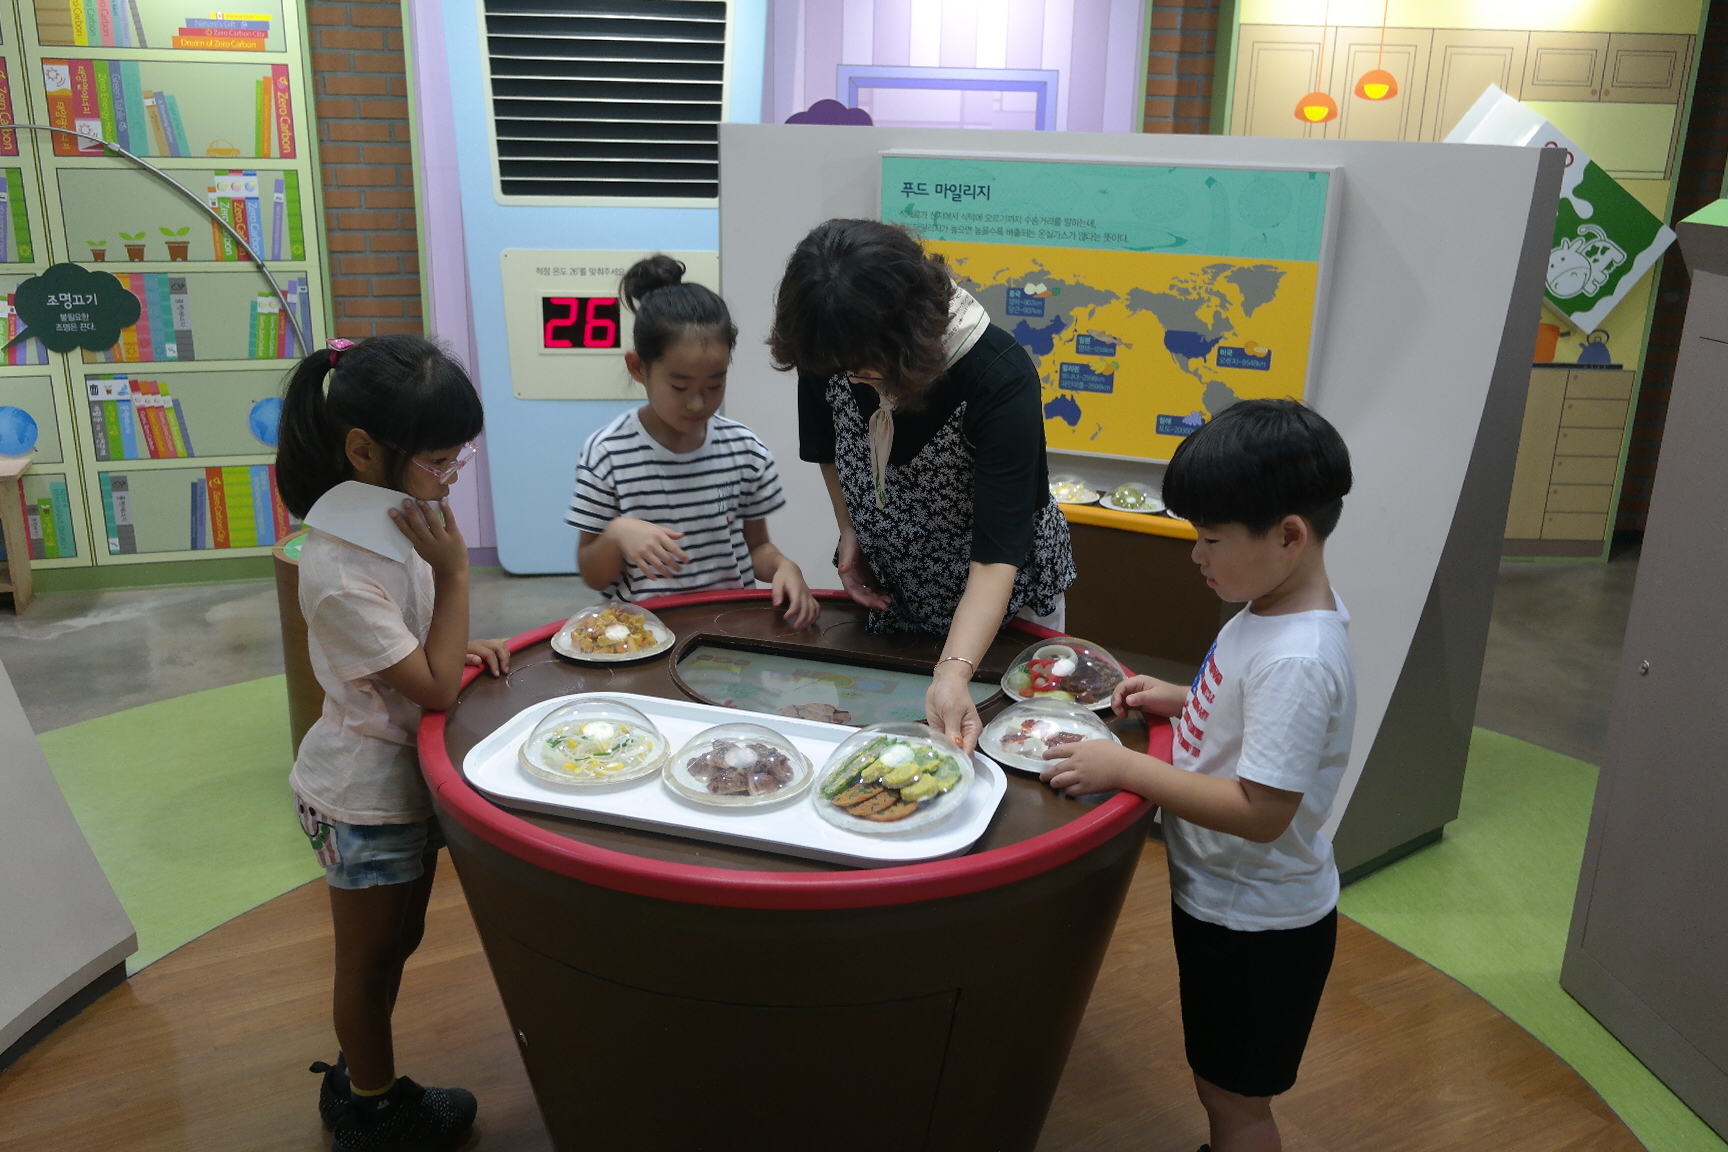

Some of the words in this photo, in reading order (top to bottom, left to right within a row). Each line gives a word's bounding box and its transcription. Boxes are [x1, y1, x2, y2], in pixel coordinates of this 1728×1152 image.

[73, 7, 84, 36] Carbon
[86, 8, 97, 36] Carbon
[100, 8, 110, 37] Carbon
[181, 38, 205, 47] Dream
[206, 39, 213, 47] of
[214, 39, 230, 48] Zero
[231, 39, 257, 49] Carbon
[213, 29, 230, 37] Zero
[231, 30, 251, 38] Carbon
[252, 30, 265, 39] City
[75, 65, 91, 115] 태양열에너지
[98, 73, 108, 92] Zero
[112, 73, 121, 96] Green
[100, 92, 110, 121] Energy
[115, 97, 126, 120] Table
[276, 91, 289, 115] Zero
[1, 112, 13, 150] Cabon
[105, 122, 113, 143] Hous
[279, 115, 291, 153] Carbon
[900, 181, 930, 198] 푸드
[934, 183, 991, 202] 마일리지
[233, 201, 244, 223] Zero
[247, 201, 257, 223] Zero
[1038, 229, 1076, 240] 온실가스가
[536, 267, 551, 276] 적정
[552, 267, 567, 276] 온도
[46, 292, 98, 310] 조명끄기
[60, 313, 90, 322] 불필요한
[544, 297, 617, 348] 26
[1220, 349, 1233, 357] 미국
[213, 490, 221, 506] Zero
[215, 506, 224, 529] Carbon
